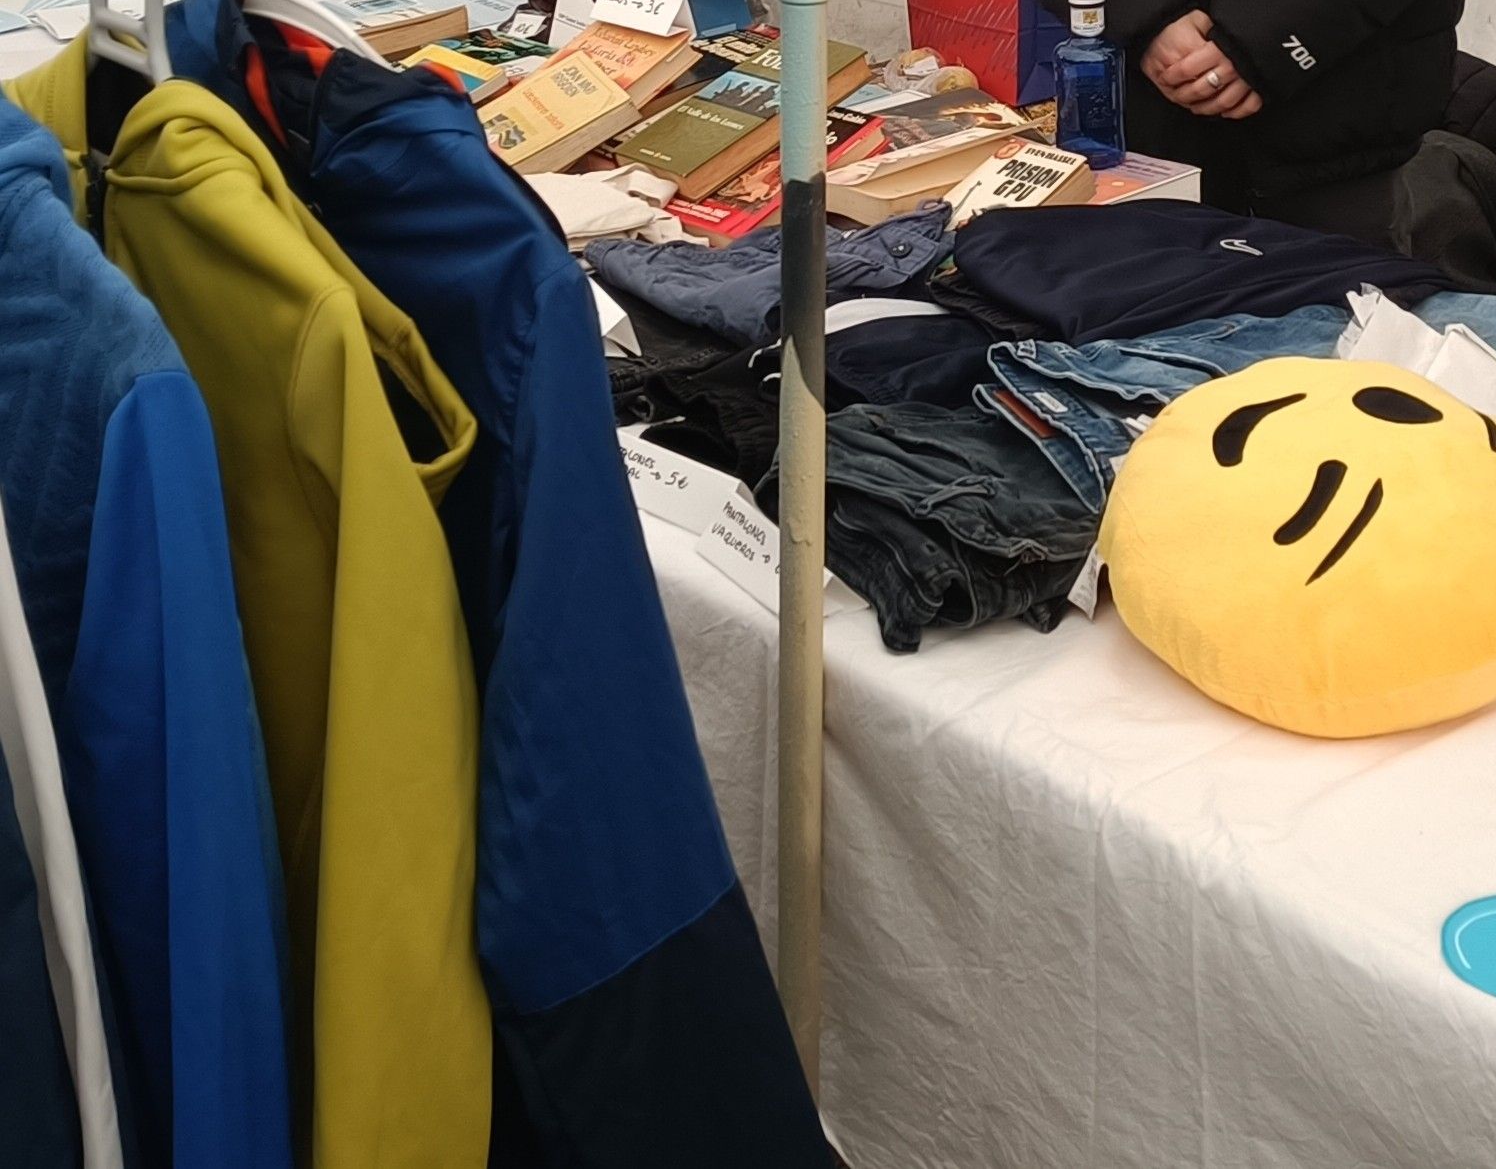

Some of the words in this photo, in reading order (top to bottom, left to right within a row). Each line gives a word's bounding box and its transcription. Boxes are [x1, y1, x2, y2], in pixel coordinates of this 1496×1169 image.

[1281, 35, 1317, 70] 700
[996, 159, 1065, 189] PRISION
[993, 180, 1037, 202] GPU
[664, 471, 689, 490] 5€
[723, 501, 767, 546] PANTALONES
[711, 523, 756, 562] VAQUEROS
